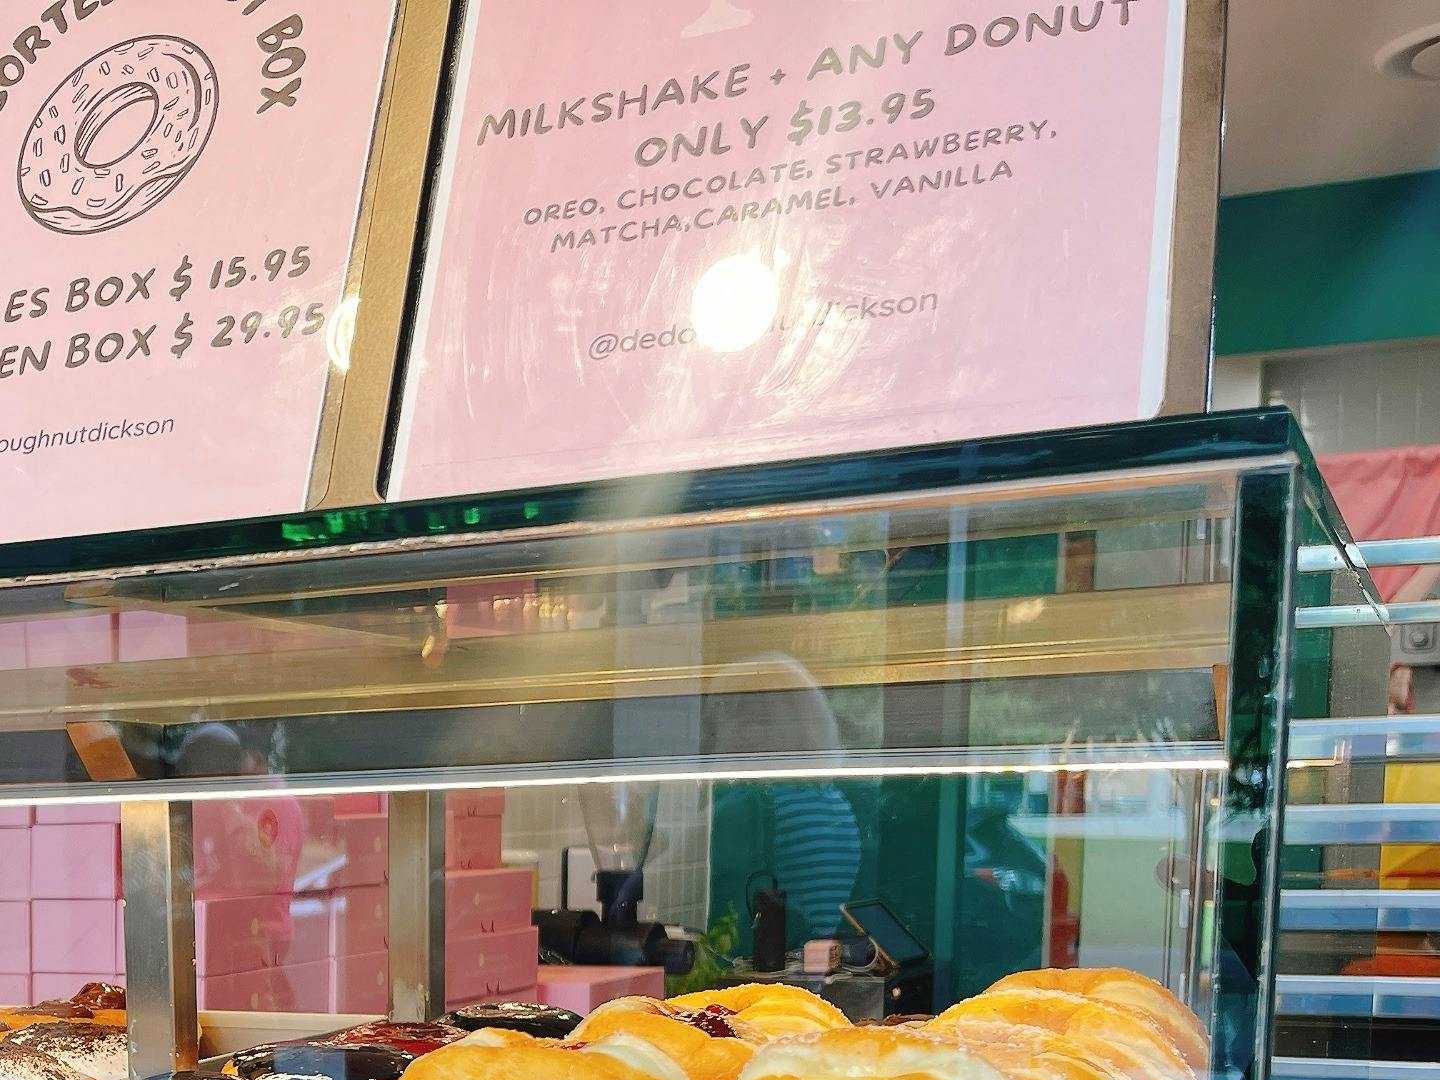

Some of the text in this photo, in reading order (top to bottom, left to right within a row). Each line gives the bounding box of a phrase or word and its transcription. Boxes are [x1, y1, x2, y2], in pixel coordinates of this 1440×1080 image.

[256, 13, 307, 115] BOX
[477, 64, 751, 146] MILKSHAKE
[807, 32, 924, 82] ANY
[944, 0, 1140, 56] DONUT
[635, 88, 937, 167] ONLY $13.95
[869, 160, 1014, 200] VANILLA
[65, 267, 156, 313] BOX
[168, 255, 194, 302] $
[210, 245, 312, 290] 15.95
[65, 325, 157, 370] BOX
[169, 312, 195, 360] $
[210, 303, 327, 349] 29.95
